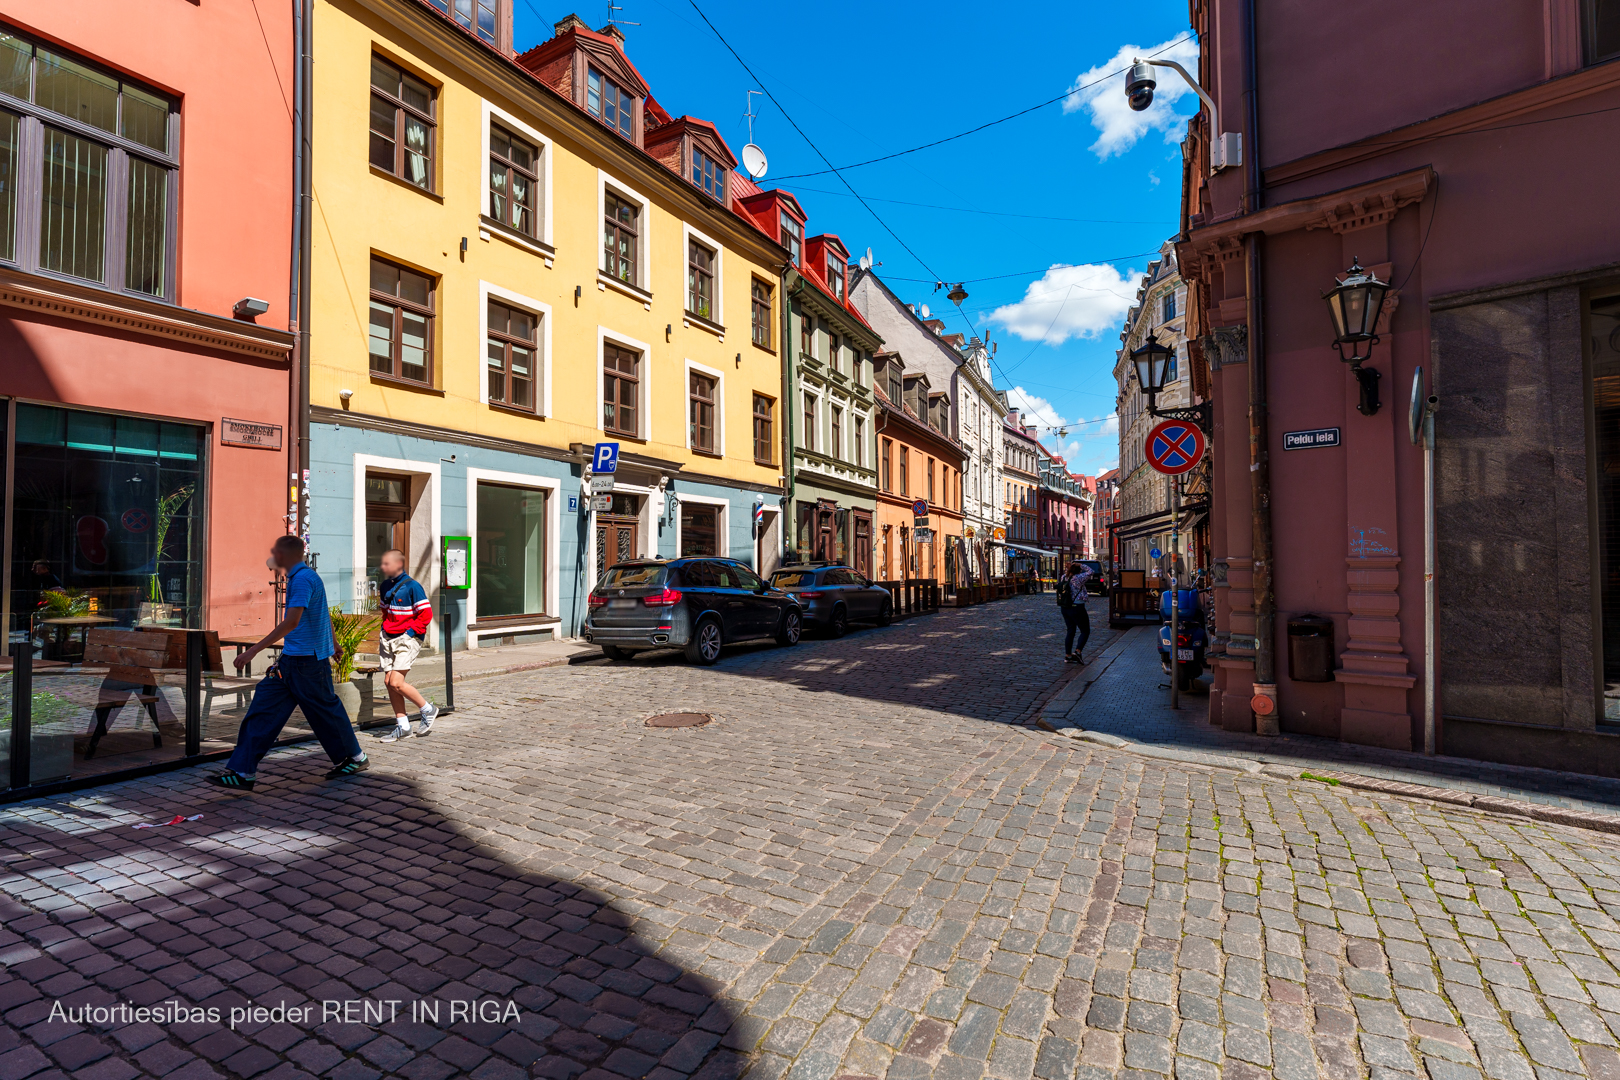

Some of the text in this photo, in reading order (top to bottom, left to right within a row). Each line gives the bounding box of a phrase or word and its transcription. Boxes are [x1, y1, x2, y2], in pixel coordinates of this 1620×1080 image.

[230, 422, 274, 433] SMOKEHOUSE
[243, 434, 262, 442] GRILL
[1287, 433, 1334, 445] Peldu iela
[597, 446, 612, 469] P
